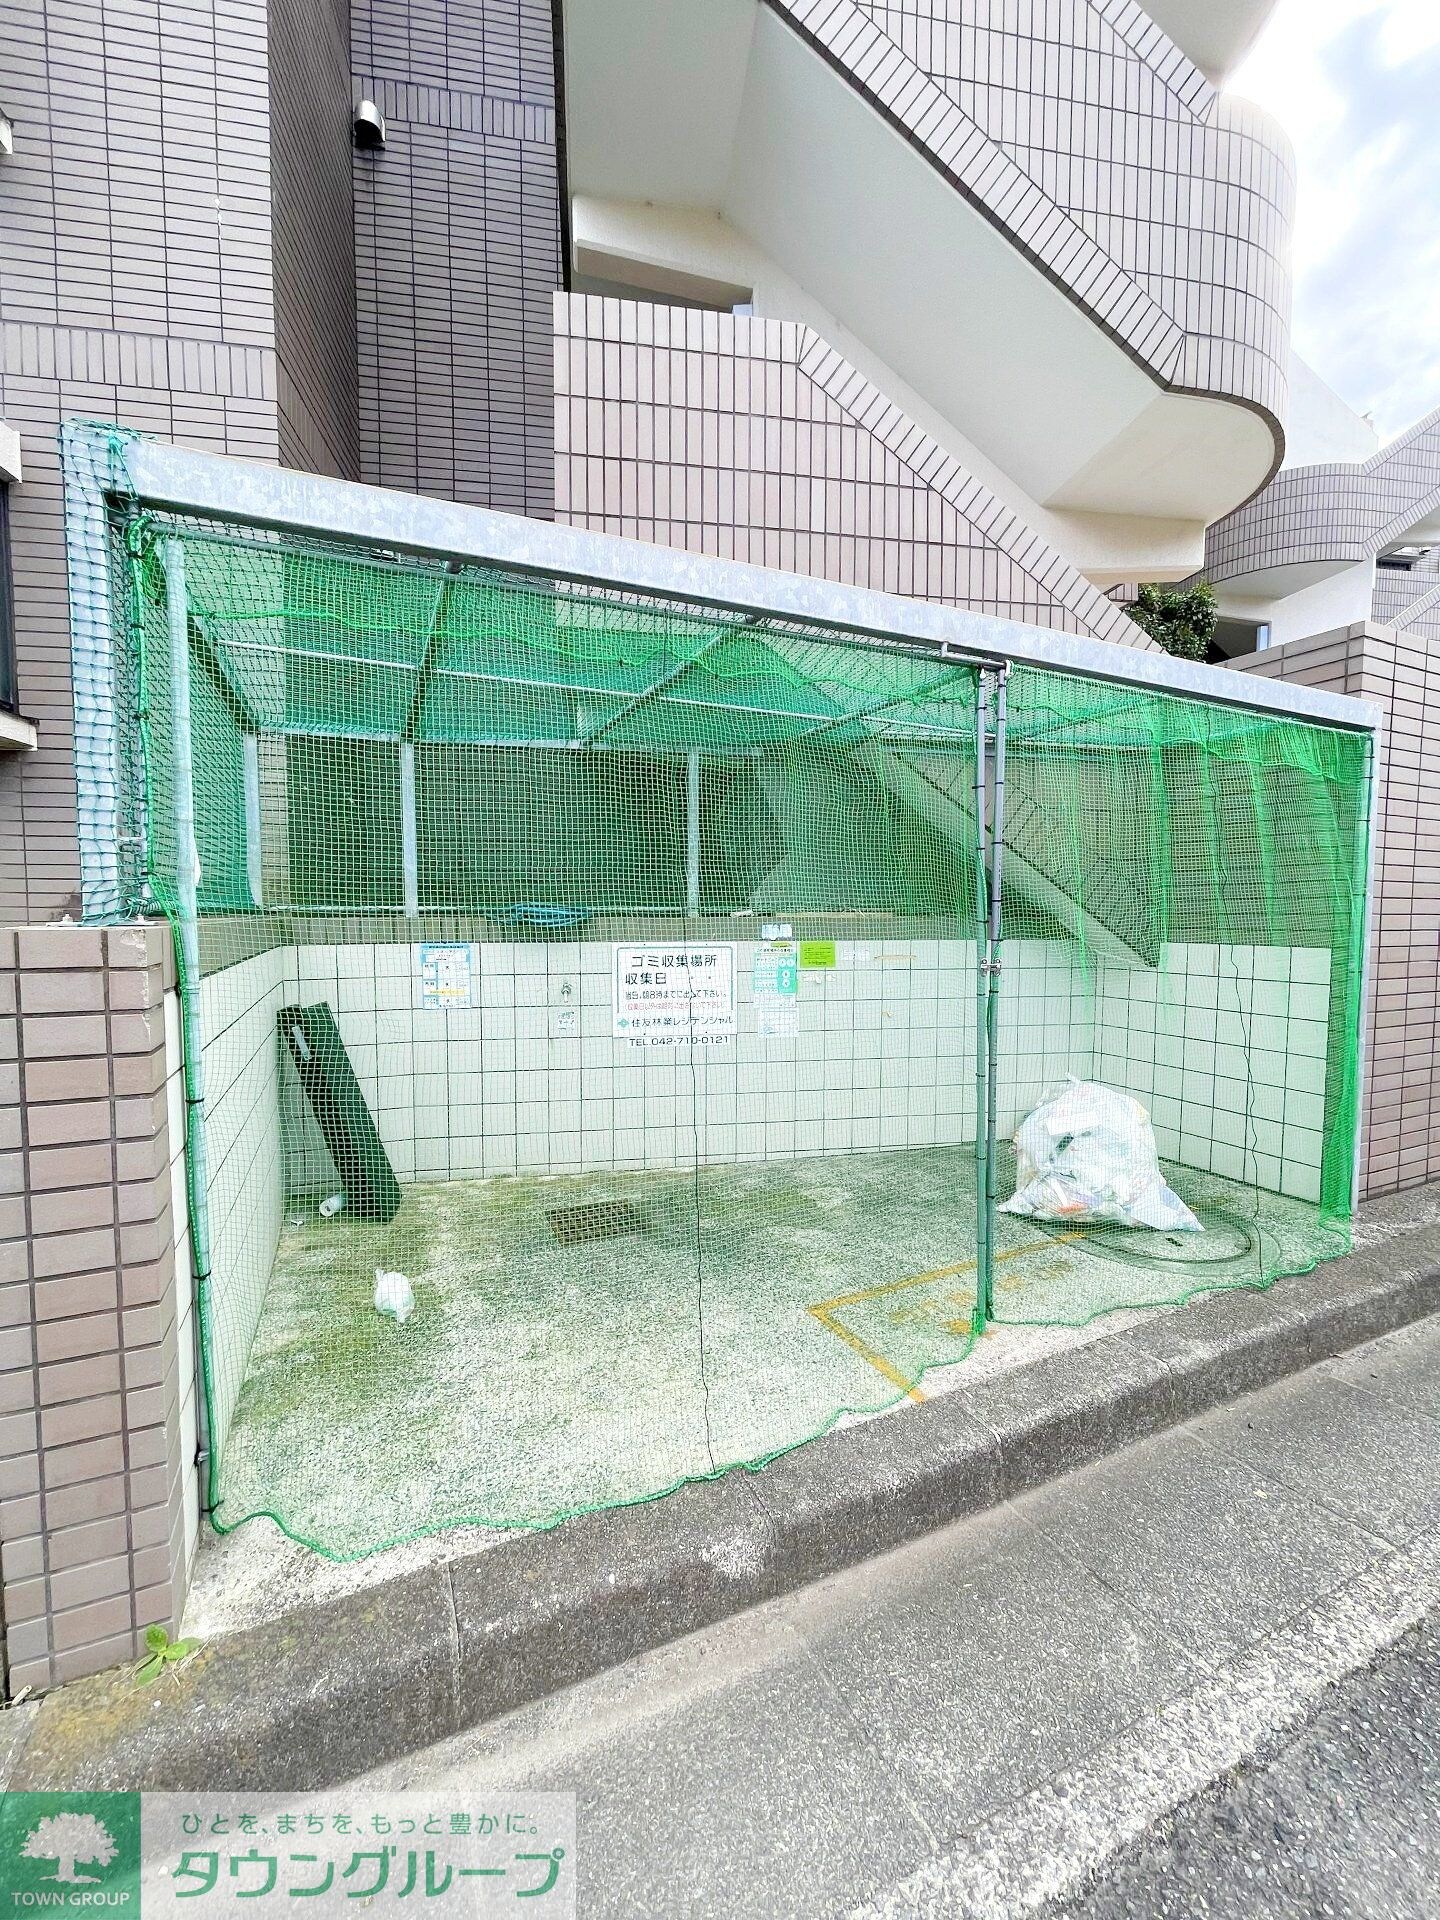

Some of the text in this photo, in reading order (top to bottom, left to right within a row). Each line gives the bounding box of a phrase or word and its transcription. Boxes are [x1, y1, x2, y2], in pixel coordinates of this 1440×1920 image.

[631, 954, 718, 969] ゴミ収集場所
[625, 972, 667, 985] 収集日
